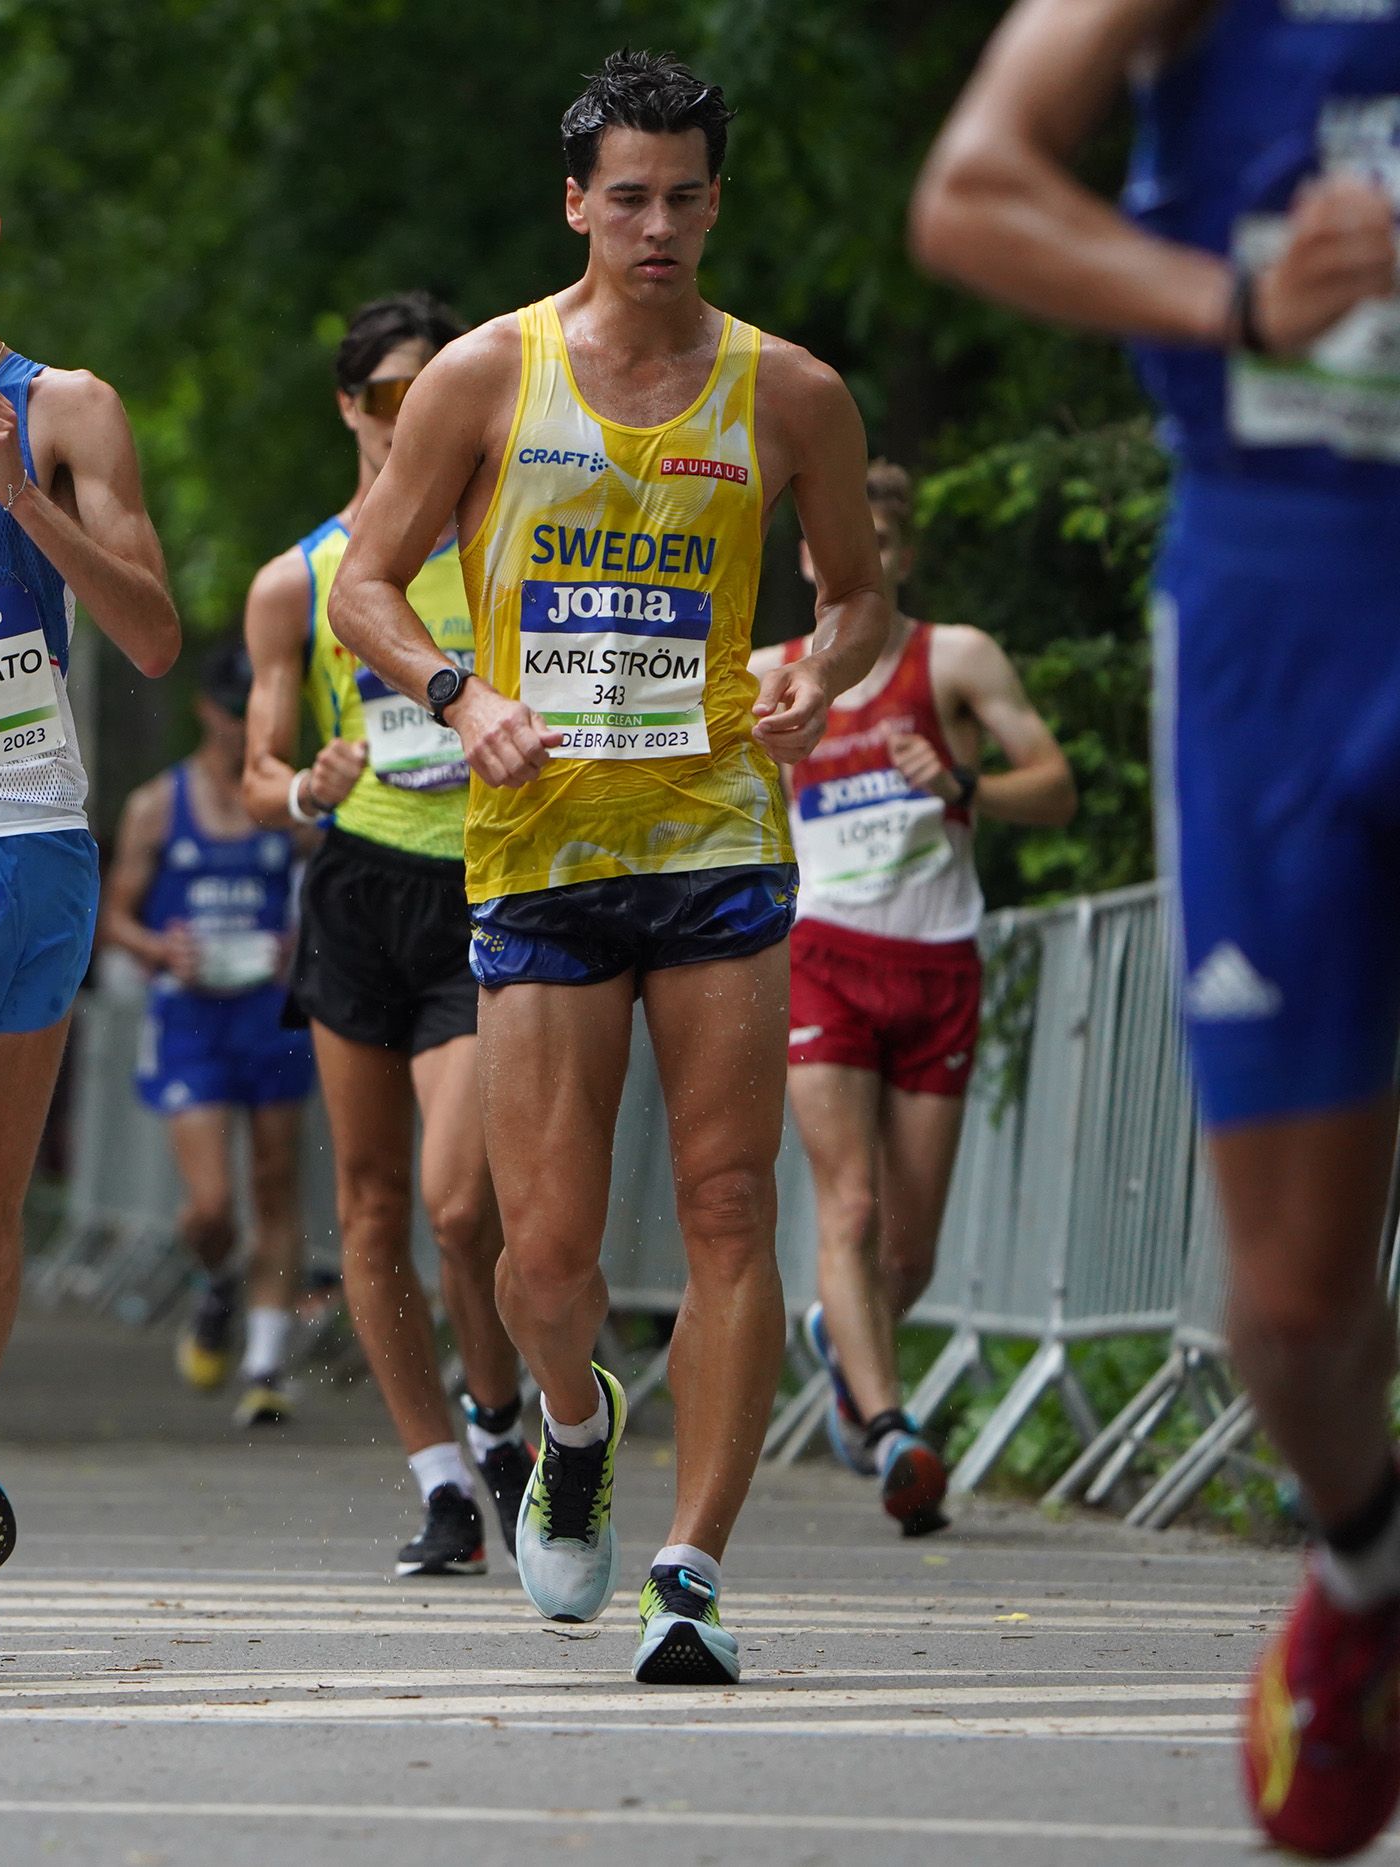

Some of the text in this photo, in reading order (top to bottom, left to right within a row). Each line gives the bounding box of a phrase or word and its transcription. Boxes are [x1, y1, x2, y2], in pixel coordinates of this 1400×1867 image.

[518, 448, 589, 468] CRAFT
[662, 459, 747, 483] BAUHAUS
[531, 524, 717, 575] SWEDEN
[524, 648, 700, 680] KARLSTRÖM
[592, 684, 626, 706] 343
[582, 713, 605, 725] RUN
[606, 713, 643, 726] CLEAN
[3, 727, 47, 753] 2023
[560, 729, 690, 749] DĚBRADY 2023
